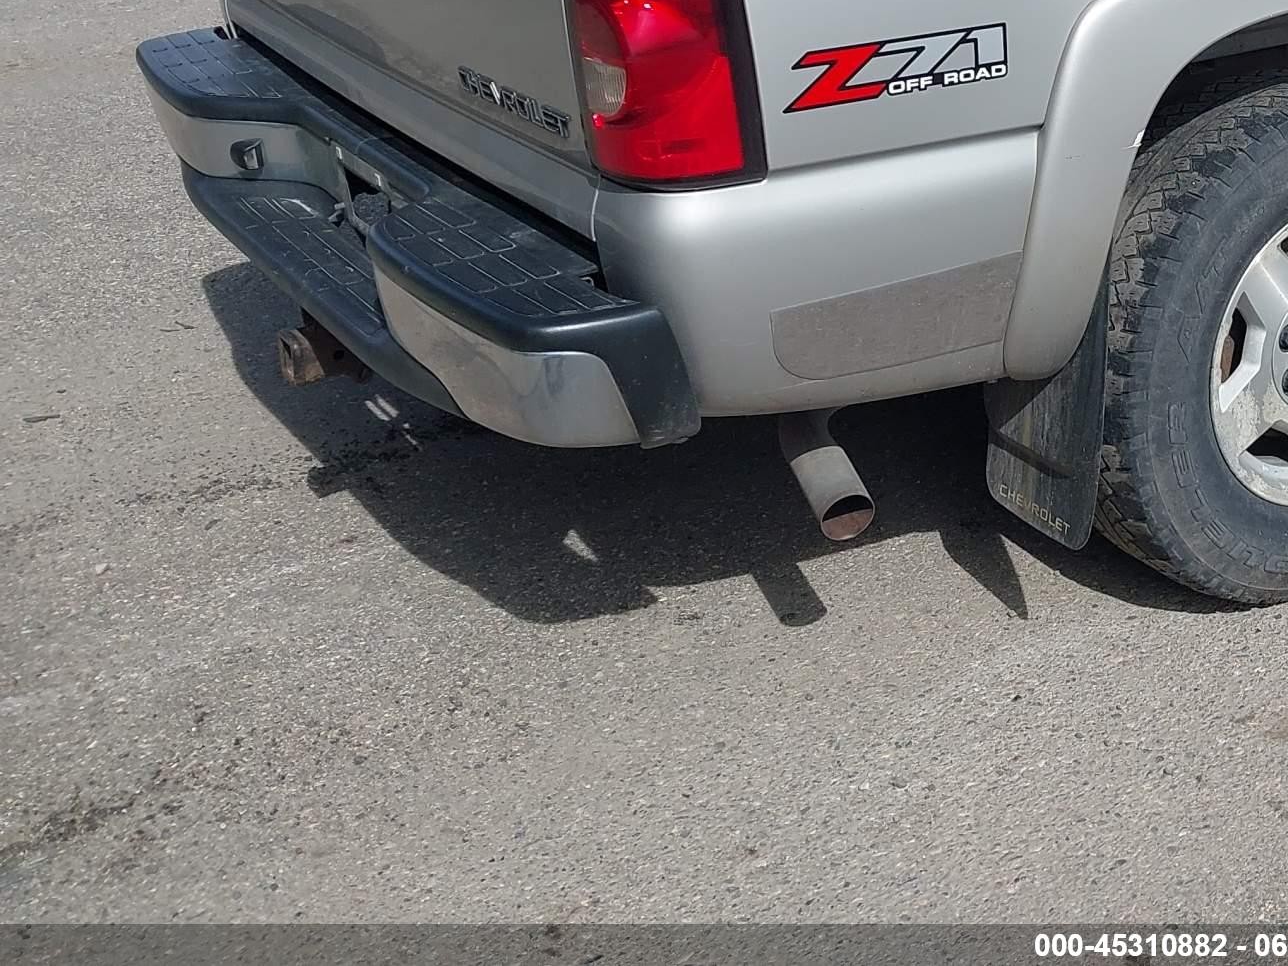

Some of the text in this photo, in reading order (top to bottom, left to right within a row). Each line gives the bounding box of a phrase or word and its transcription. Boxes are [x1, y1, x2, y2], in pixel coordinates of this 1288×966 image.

[783, 22, 1008, 114] Z71
[887, 64, 1007, 95] OFF ROAD
[457, 65, 571, 138] CHEVROLET
[999, 484, 1072, 536] CHEVROLET
